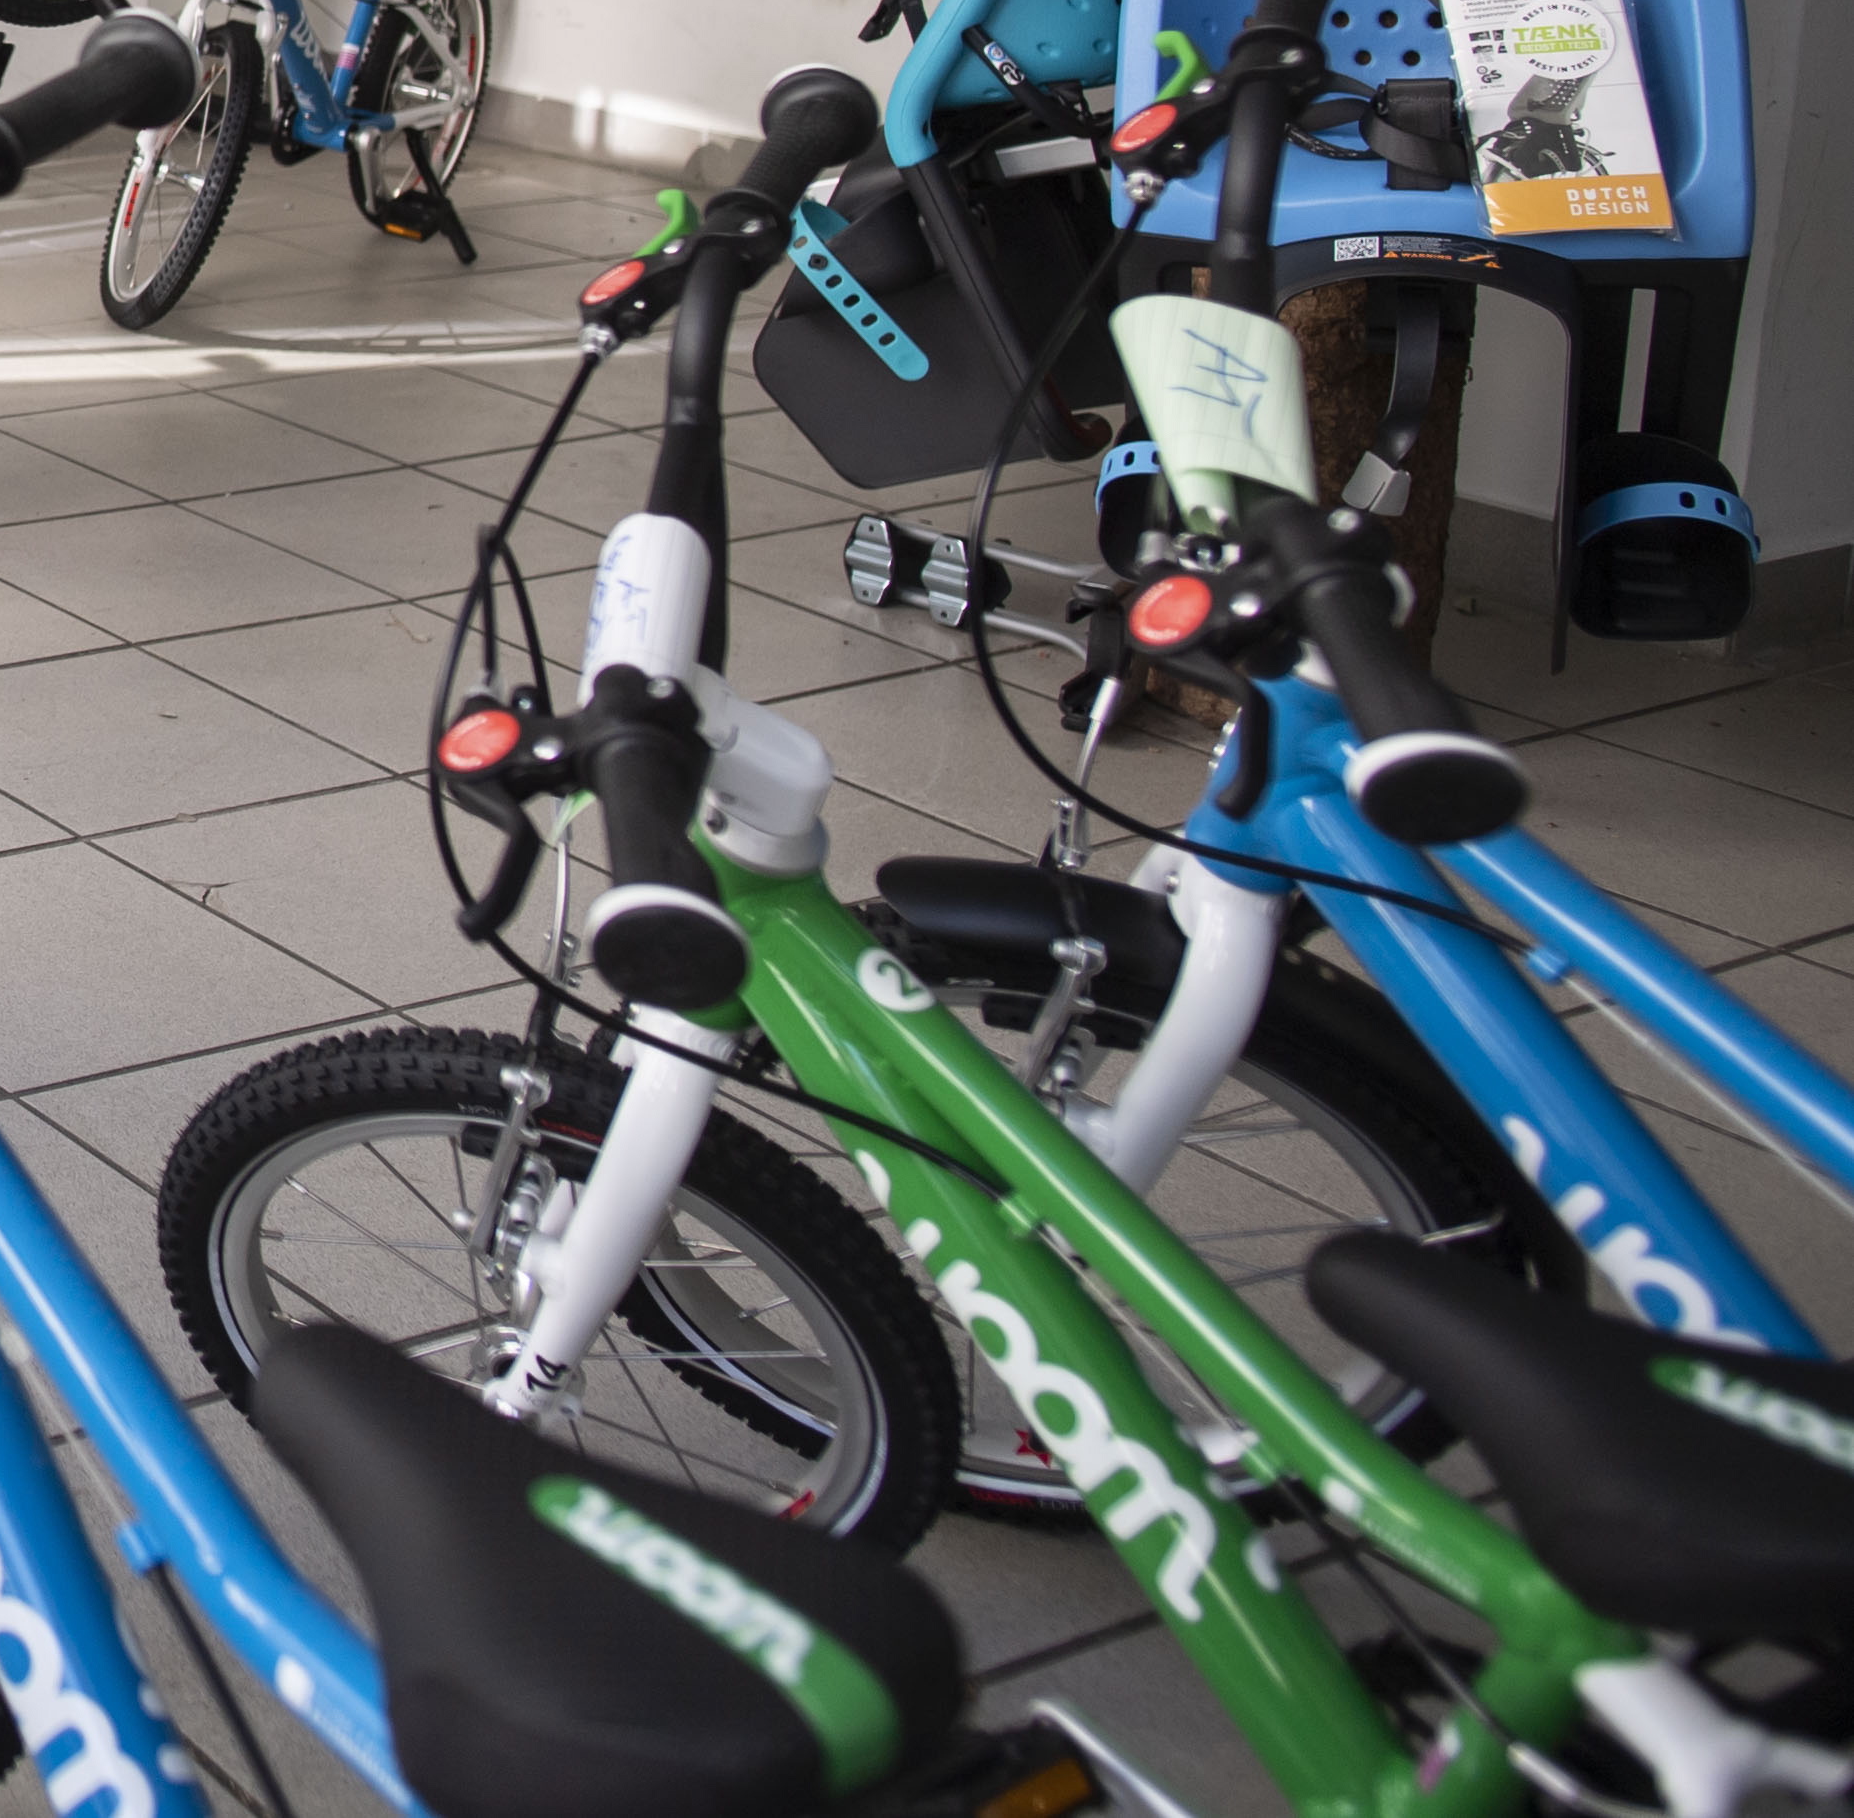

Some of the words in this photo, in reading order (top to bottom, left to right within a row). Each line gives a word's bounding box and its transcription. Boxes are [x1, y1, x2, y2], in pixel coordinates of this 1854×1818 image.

[1511, 23, 1599, 42] TÆNK
[1566, 185, 1648, 202] DUTCH
[1569, 201, 1651, 217] DESIGN
[526, 1353, 569, 1392] 14
